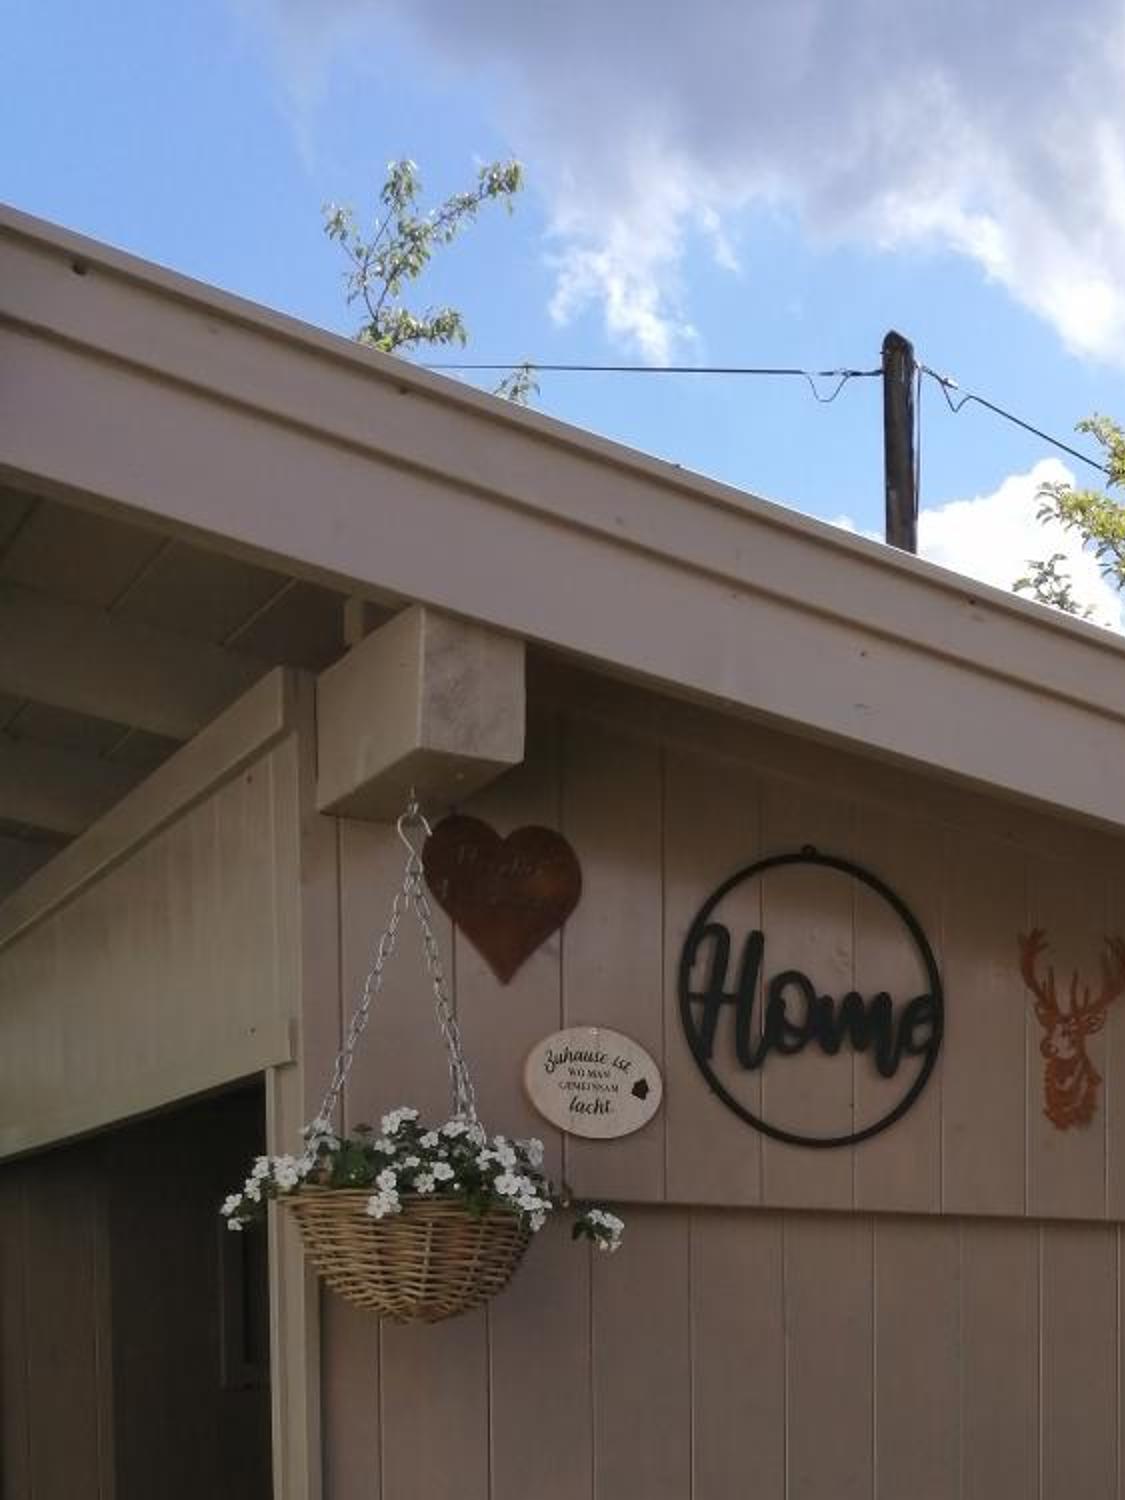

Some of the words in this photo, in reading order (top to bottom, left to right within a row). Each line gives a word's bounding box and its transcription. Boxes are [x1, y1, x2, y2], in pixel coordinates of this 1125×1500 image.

[683, 922, 940, 1079] Home
[544, 1046, 608, 1074] Zuhause
[611, 1055, 632, 1074] ist
